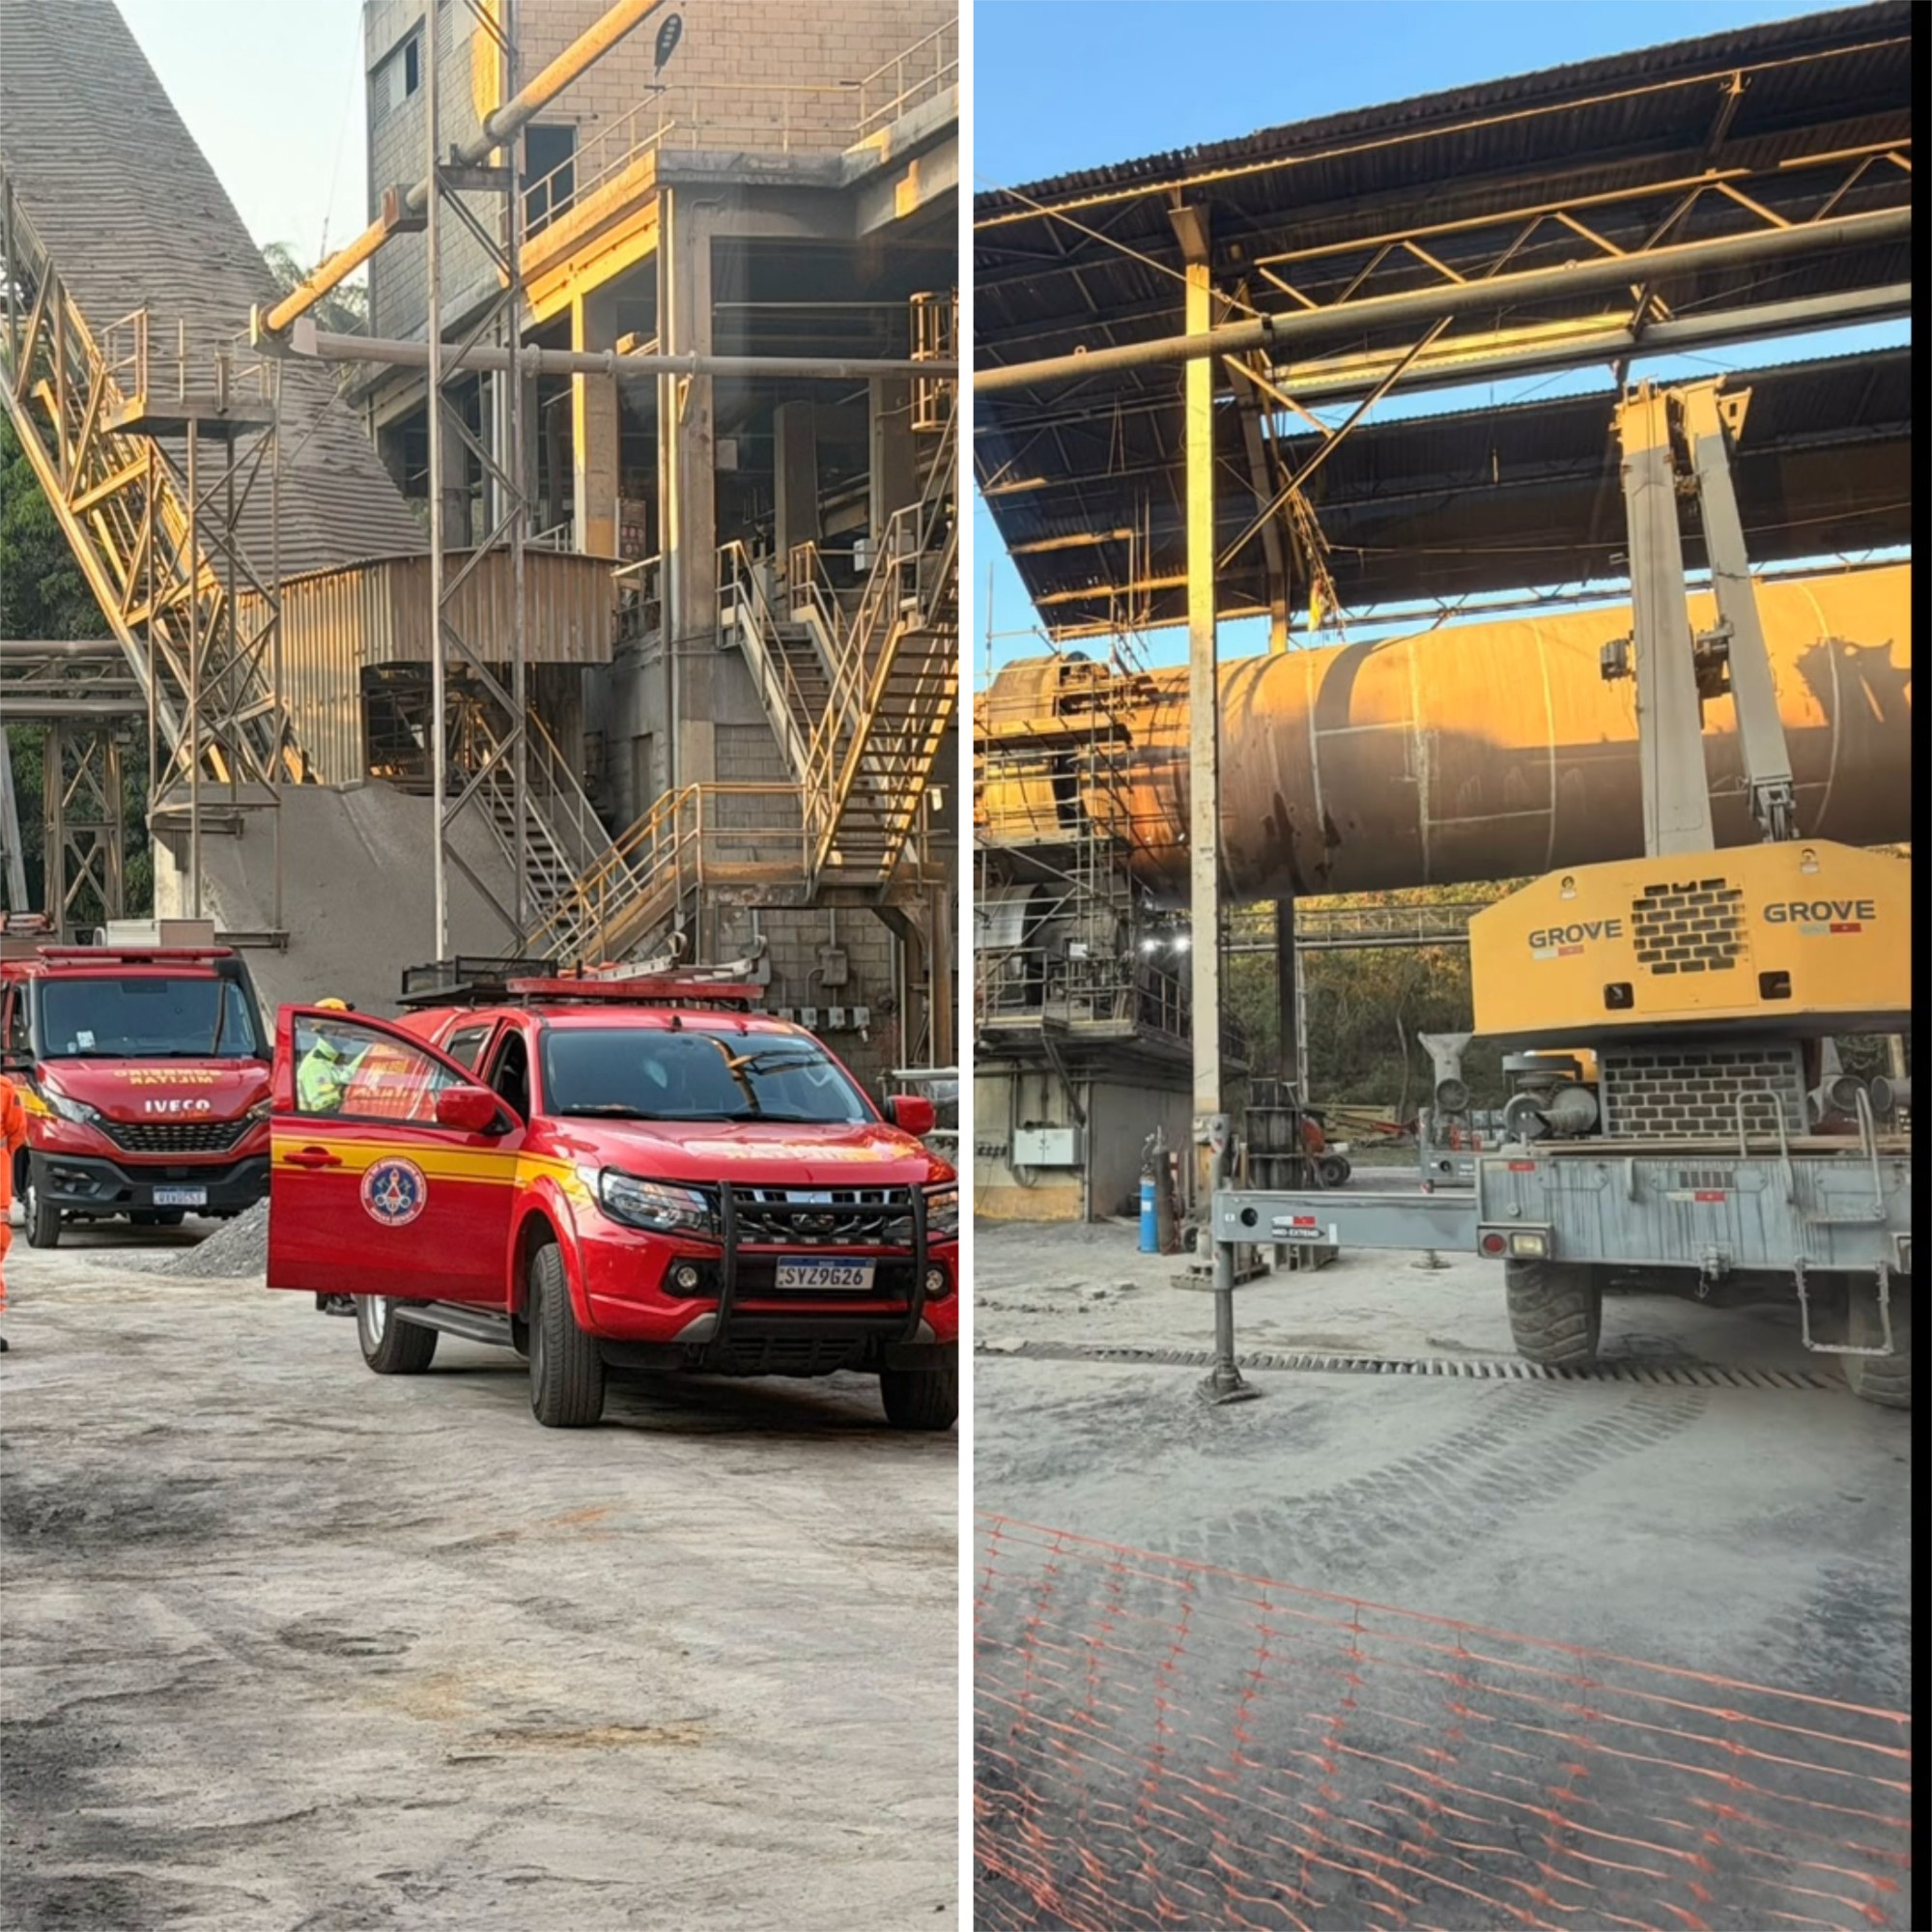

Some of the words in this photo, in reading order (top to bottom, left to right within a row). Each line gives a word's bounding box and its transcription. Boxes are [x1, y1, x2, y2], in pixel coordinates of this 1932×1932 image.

[1762, 898, 1877, 923] GROVE
[1528, 919, 1624, 949] GROVE
[144, 1099, 211, 1113] IVECO
[784, 1267, 864, 1286] SYZ9G26
